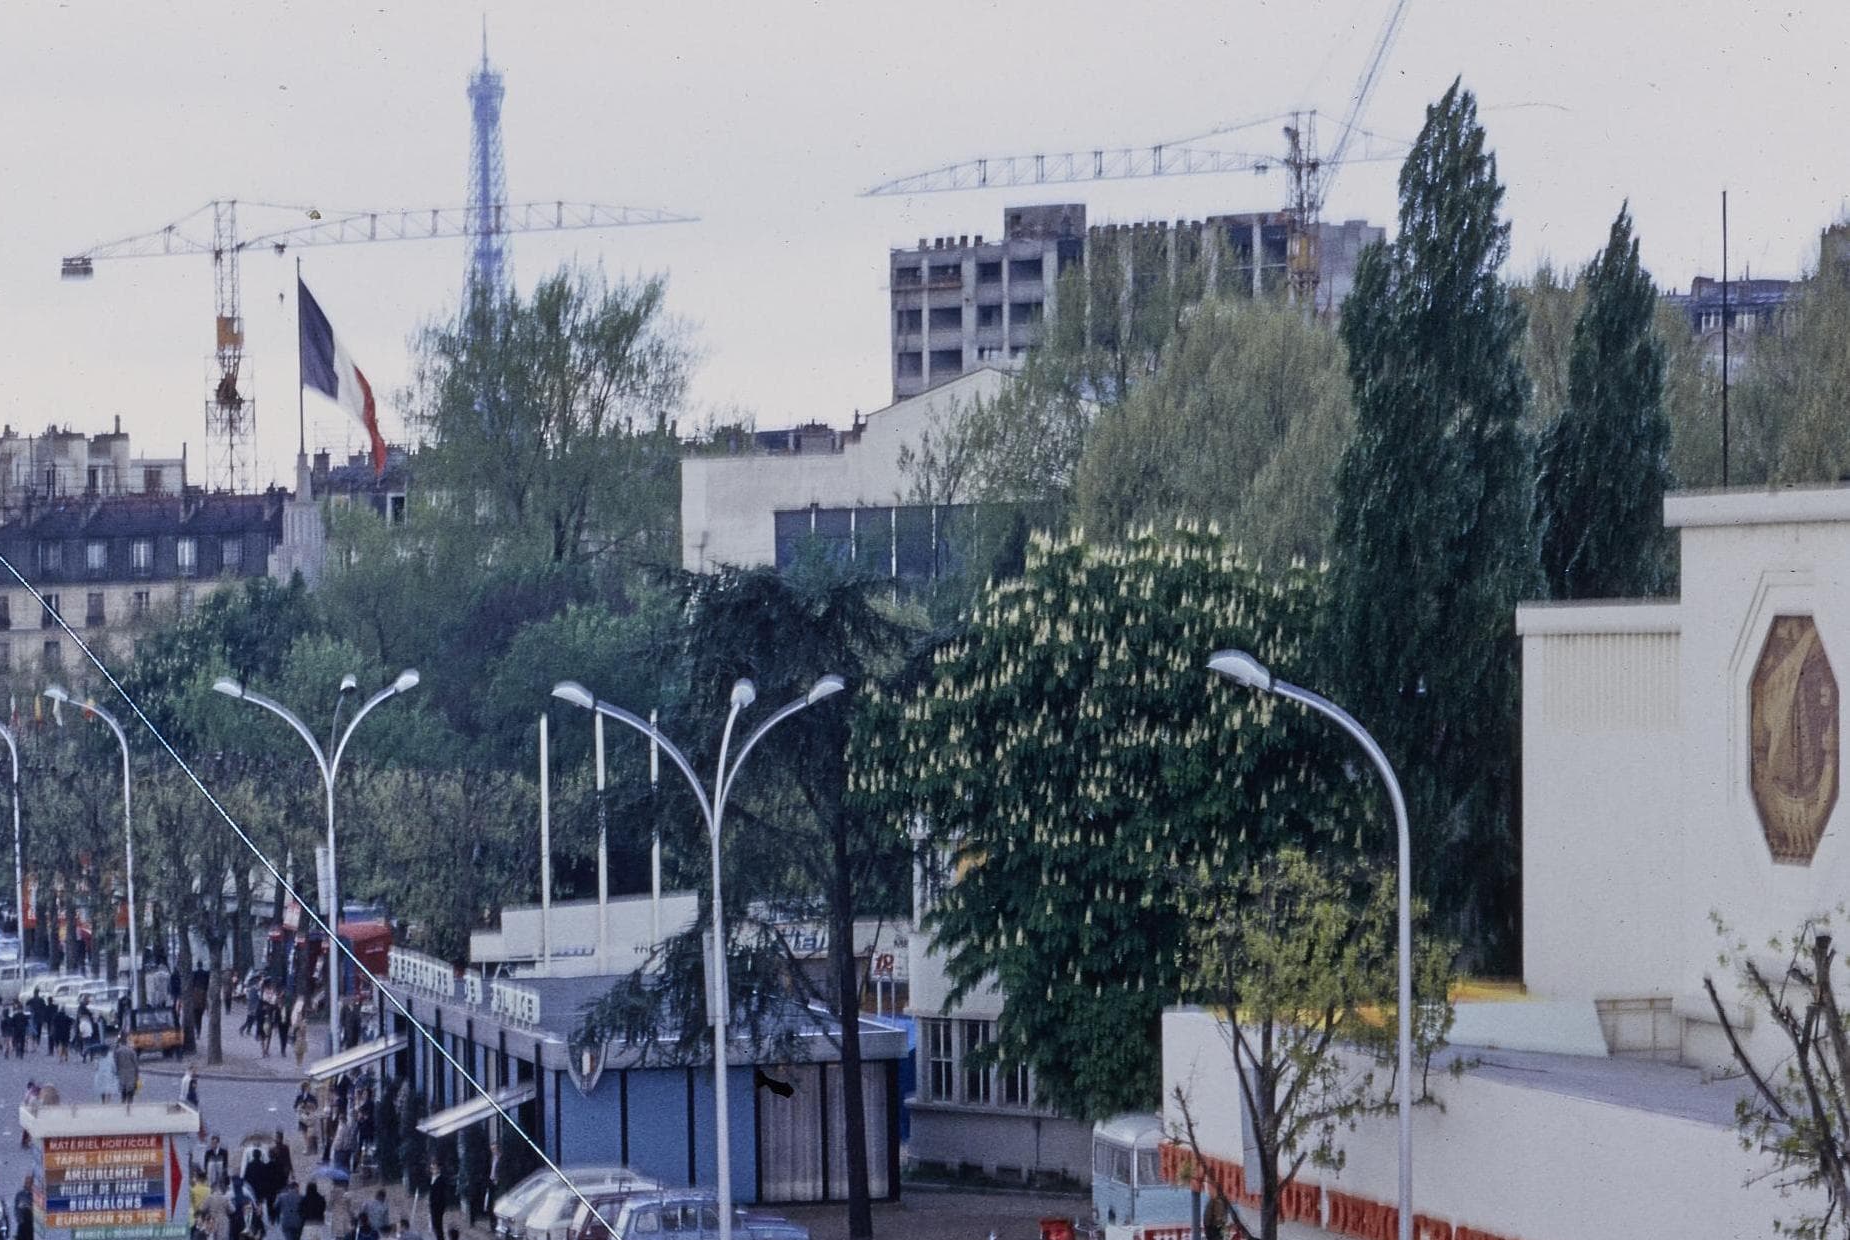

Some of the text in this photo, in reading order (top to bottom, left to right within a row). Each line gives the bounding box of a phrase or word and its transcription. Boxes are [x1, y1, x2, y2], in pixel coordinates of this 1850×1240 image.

[60, 1182, 149, 1197] VILLAGE DE FRANCE
[68, 1196, 143, 1212] BUNGALOWS
